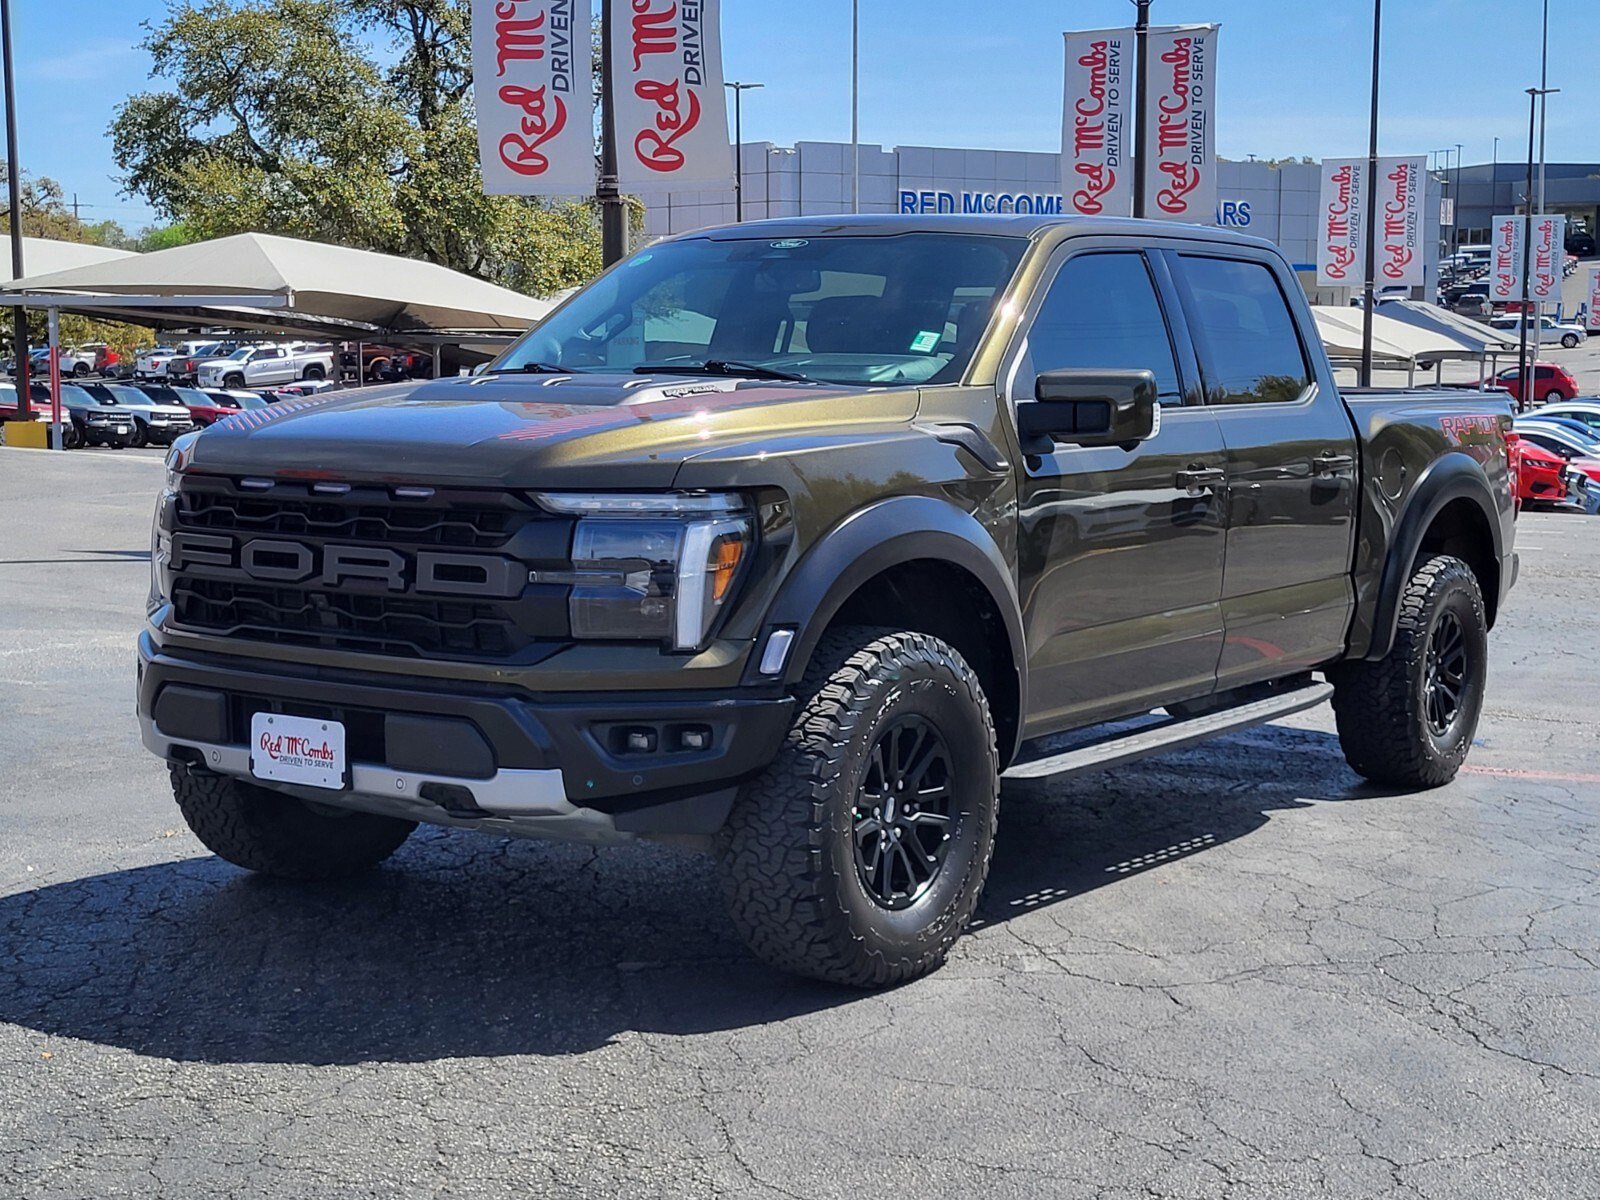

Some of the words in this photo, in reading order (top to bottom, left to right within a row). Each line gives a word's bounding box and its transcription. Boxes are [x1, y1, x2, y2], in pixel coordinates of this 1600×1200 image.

[551, 0, 570, 92] DRIVEN
[1109, 40, 1121, 84] SERVE
[1192, 37, 1204, 80] SERVE
[1074, 40, 1108, 158] McCombs
[1108, 88, 1119, 108] TO
[1158, 37, 1192, 157] McCombs
[1192, 85, 1203, 105] TO
[499, 84, 567, 176] Red
[634, 78, 701, 172] Red
[1107, 113, 1119, 167] DRIVEN
[1191, 110, 1203, 165] DRIVEN
[1073, 162, 1116, 215] Red
[1157, 160, 1200, 214] Red
[1351, 165, 1360, 194] SERVE
[1408, 163, 1417, 192] SERVE
[900, 190, 954, 214] RED
[1327, 165, 1351, 242] McCombs
[1350, 196, 1359, 210] TO
[1384, 164, 1408, 241] McCombs
[1407, 195, 1416, 209] TO
[1349, 212, 1358, 248] DRIVEN
[1406, 211, 1415, 247] DRIVEN
[1497, 220, 1513, 271] McCombs
[1536, 219, 1552, 271] McCombs
[1325, 245, 1355, 278] Red
[1383, 244, 1412, 278] Red
[1495, 273, 1516, 296] Red
[1534, 273, 1555, 296] Red
[1439, 414, 1504, 445] RAPTOR
[170, 532, 527, 598] FORD
[260, 732, 281, 760] Red
[284, 735, 334, 760] McCombs
[279, 755, 303, 765] DRIVEN
[304, 758, 314, 766] TO
[314, 760, 334, 769] SERVE
